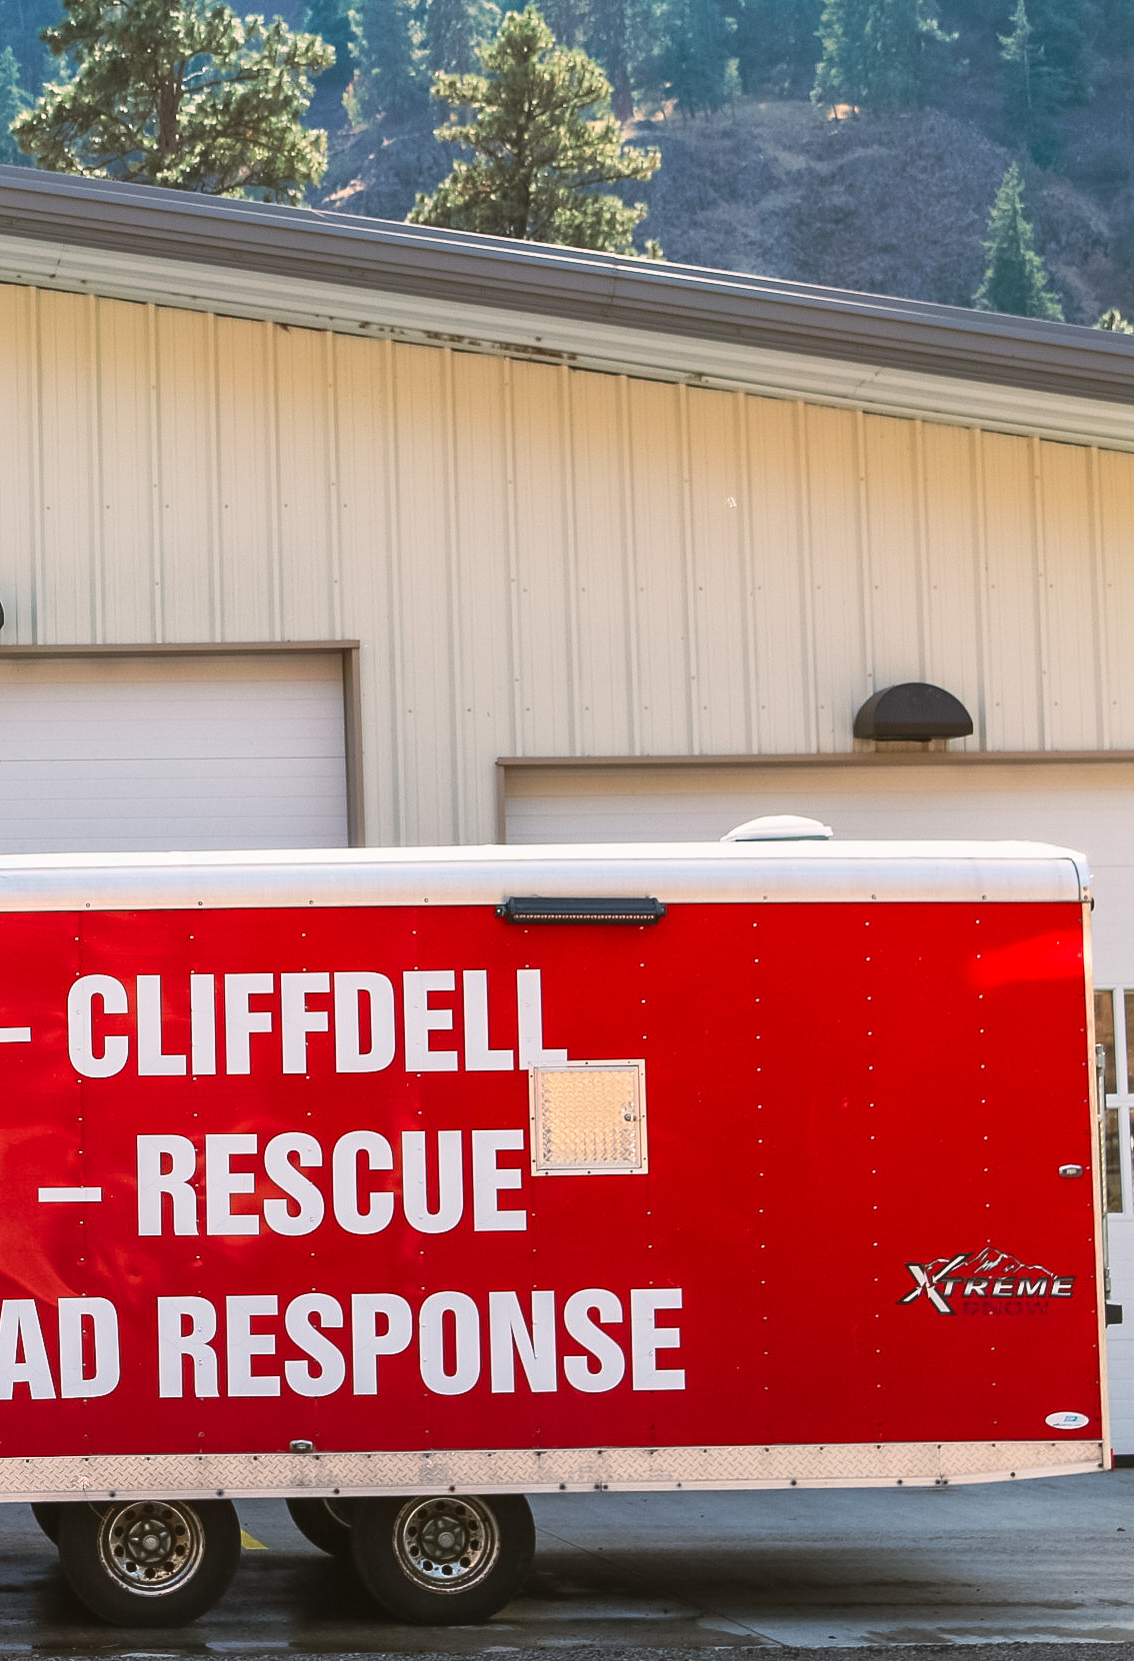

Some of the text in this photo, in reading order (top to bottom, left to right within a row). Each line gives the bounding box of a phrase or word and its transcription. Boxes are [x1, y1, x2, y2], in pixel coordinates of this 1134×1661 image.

[67, 969, 568, 1078] CLIFFDELL
[136, 1130, 528, 1236] RESCUE
[895, 1252, 1076, 1316] XTREME
[157, 1288, 686, 1398] RESPONSE
